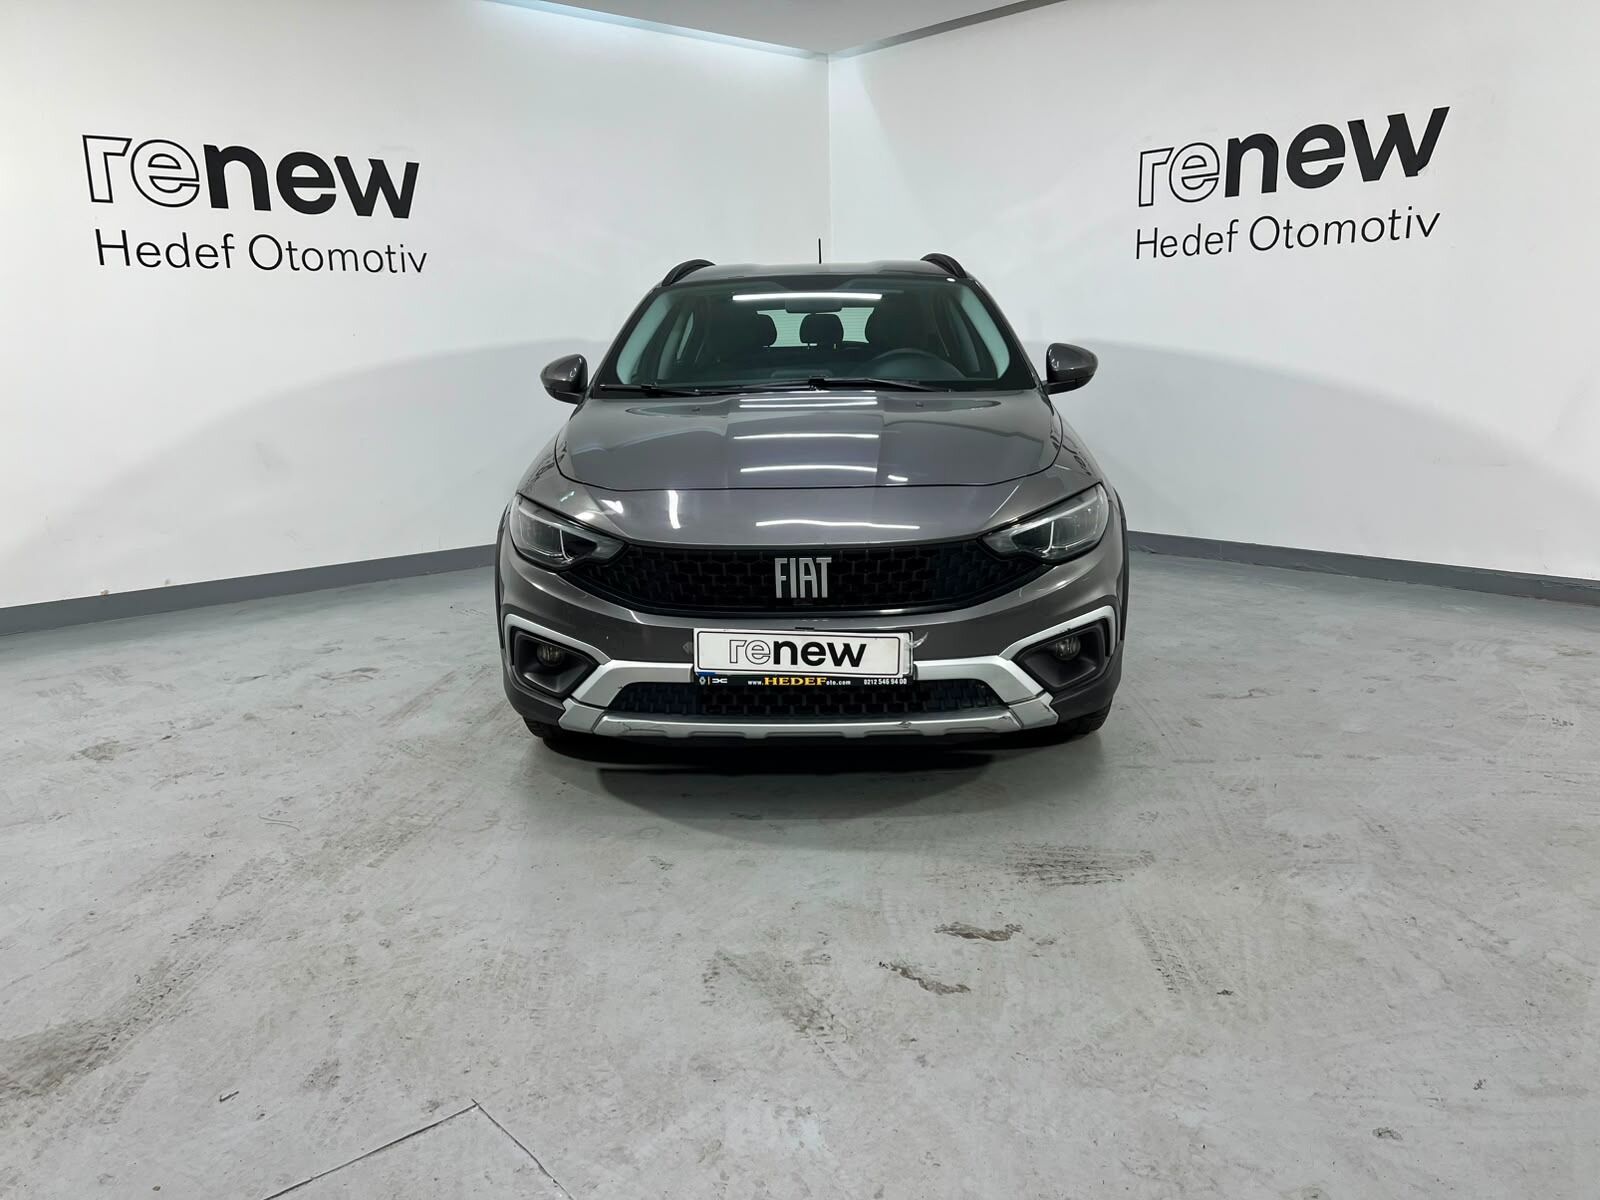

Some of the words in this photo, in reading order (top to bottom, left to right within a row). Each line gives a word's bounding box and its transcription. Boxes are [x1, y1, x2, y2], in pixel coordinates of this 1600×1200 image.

[82, 134, 420, 219] renew
[1139, 106, 1450, 208] renew
[95, 228, 235, 269] Hedef
[248, 234, 428, 274] Otomotiv
[1136, 219, 1239, 259] Hedef
[1249, 206, 1441, 252] Otomotiv
[774, 557, 832, 599] FIAT
[729, 639, 867, 668] renew
